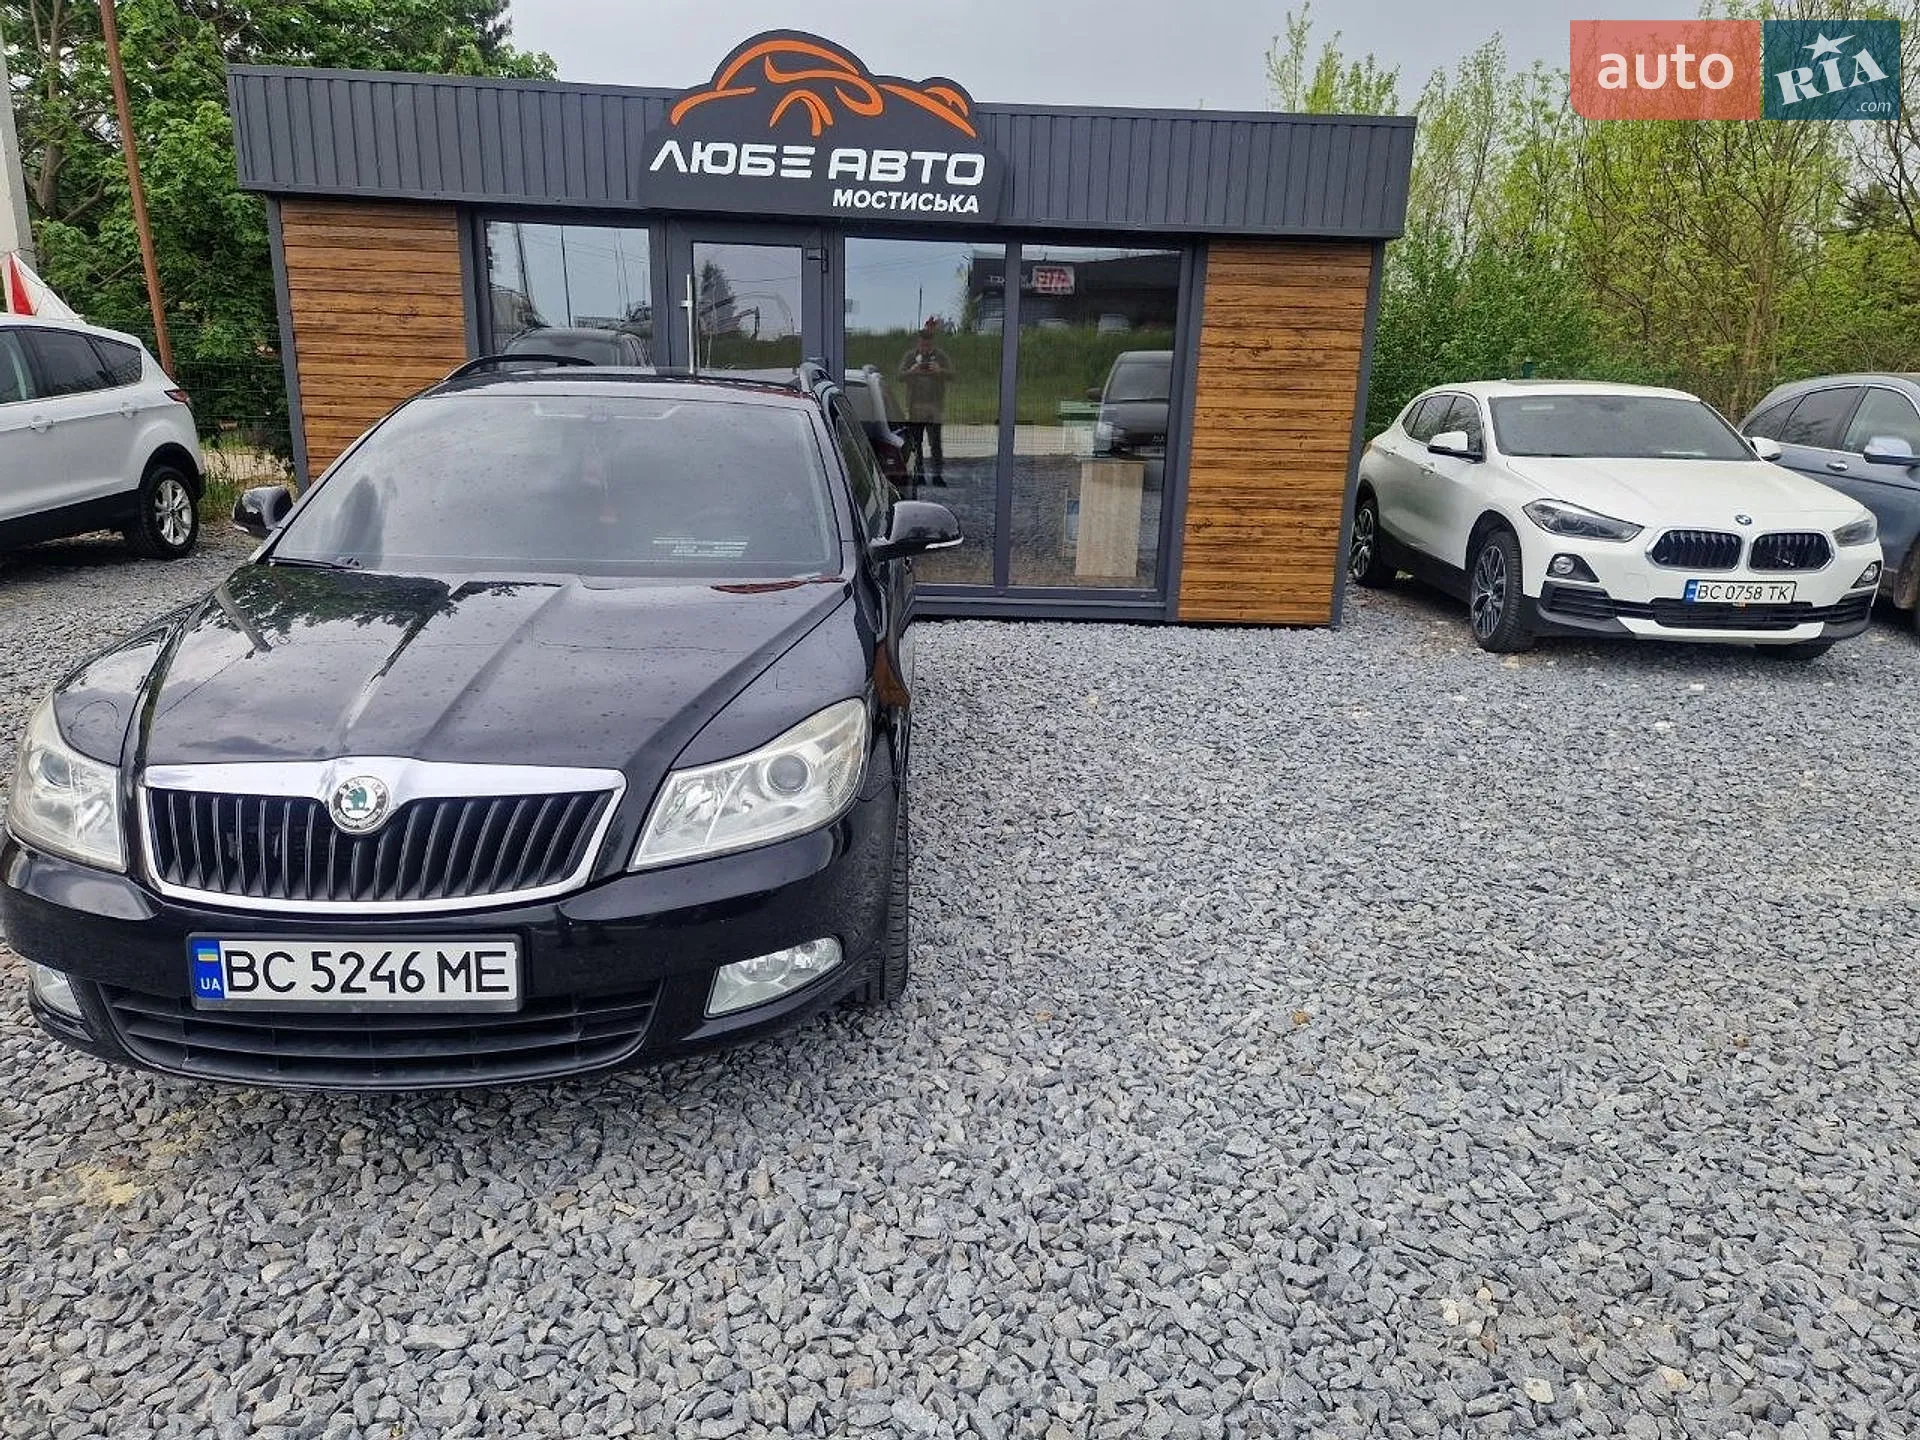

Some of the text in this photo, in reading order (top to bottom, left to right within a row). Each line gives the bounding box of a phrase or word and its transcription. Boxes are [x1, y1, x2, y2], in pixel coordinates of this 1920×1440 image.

[650, 139, 986, 186] ЛЮБЕ АВТО
[832, 189, 979, 213] МОСТИСЬКА
[1698, 585, 1721, 600] BC
[1725, 586, 1763, 600] 0758
[1768, 586, 1790, 600] TK
[224, 950, 510, 994] BC 5246 ME
[200, 977, 221, 992] UA
